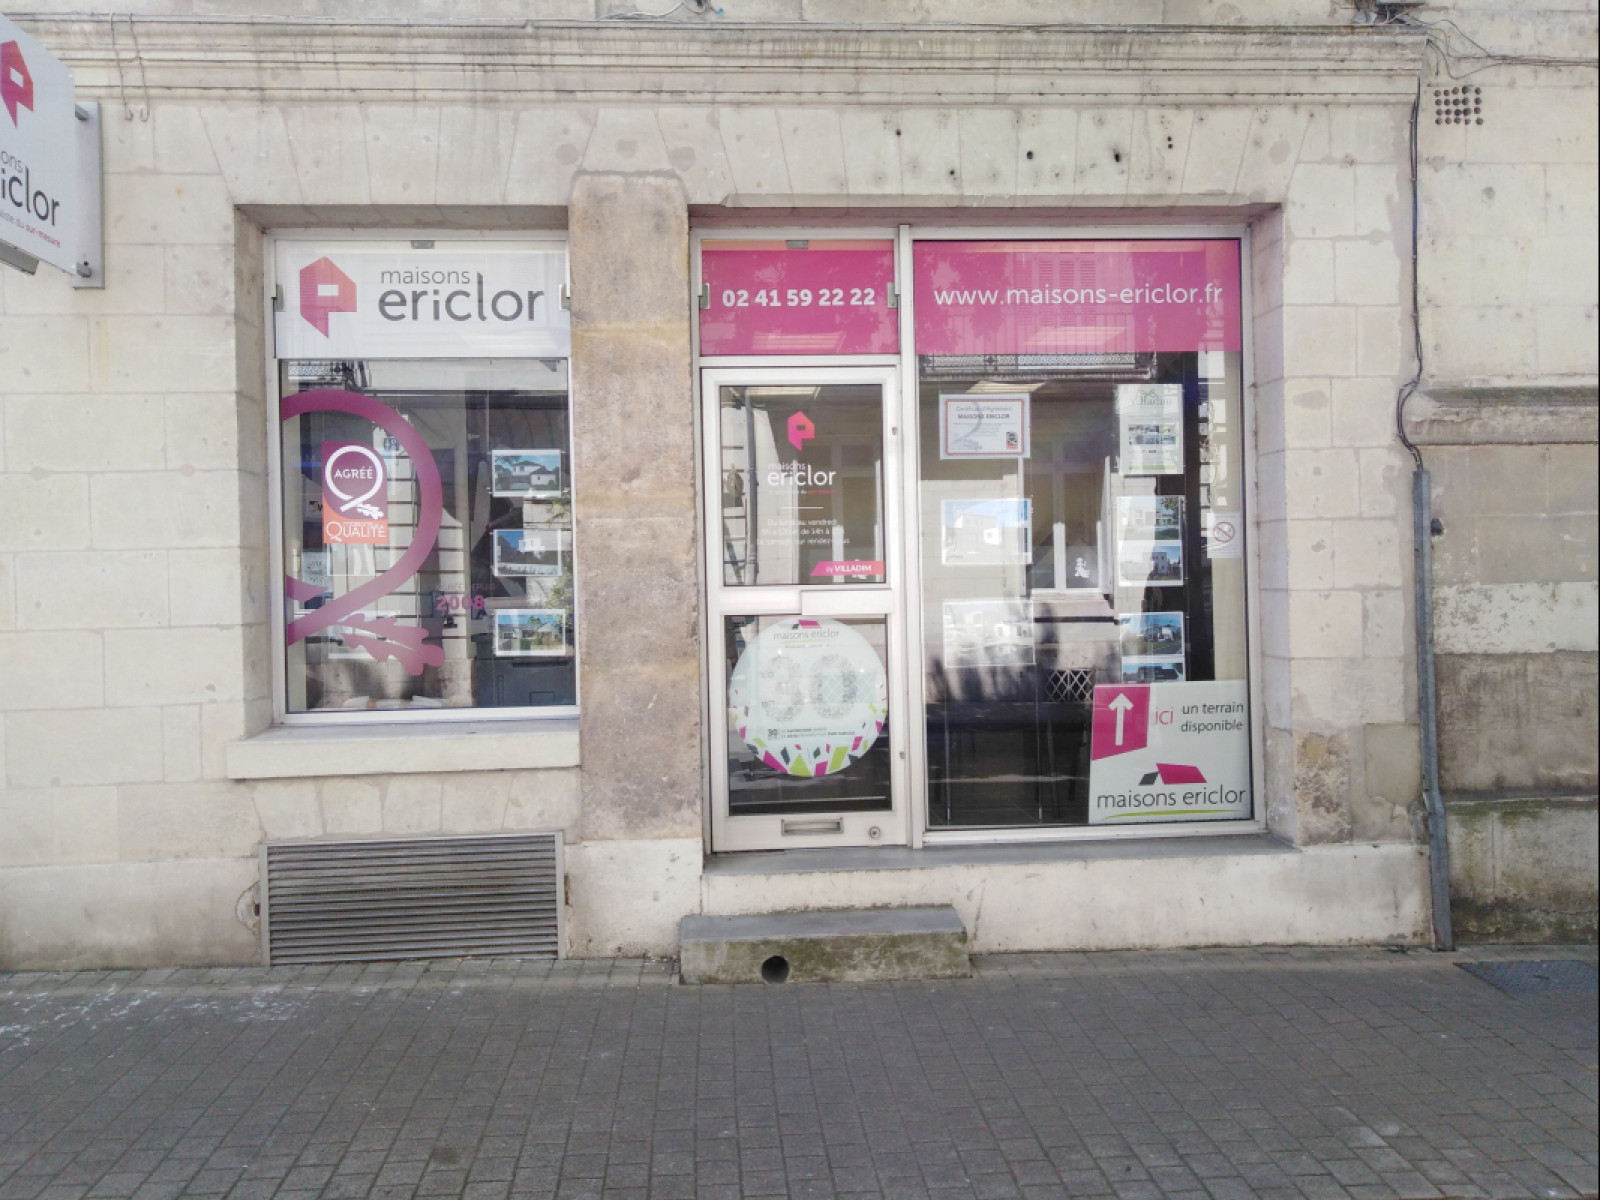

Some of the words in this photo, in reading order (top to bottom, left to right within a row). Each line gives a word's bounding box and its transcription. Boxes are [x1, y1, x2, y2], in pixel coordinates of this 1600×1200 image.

[1, 164, 60, 226] iclor
[381, 266, 471, 284] maisons
[378, 272, 544, 321] ericlor
[722, 289, 749, 307] 02
[754, 289, 781, 307] 41
[786, 288, 812, 307] 59
[818, 288, 844, 306] 22
[850, 287, 875, 306] 22
[933, 283, 1223, 305] www.maisons-ericlor.fr
[334, 466, 373, 479] AGRÉÉ
[767, 464, 837, 486] ericlor
[768, 461, 806, 470] maisons
[326, 521, 386, 541] QUALITÉ
[436, 594, 485, 610] 2008
[773, 629, 809, 640] maisons
[810, 628, 840, 639] ericlor
[1155, 706, 1174, 725] ici
[1182, 704, 1199, 715] un
[1202, 702, 1245, 715] terrain
[1181, 719, 1244, 734] disponible
[1097, 789, 1177, 808] maisons
[1182, 784, 1246, 806] ericlor
